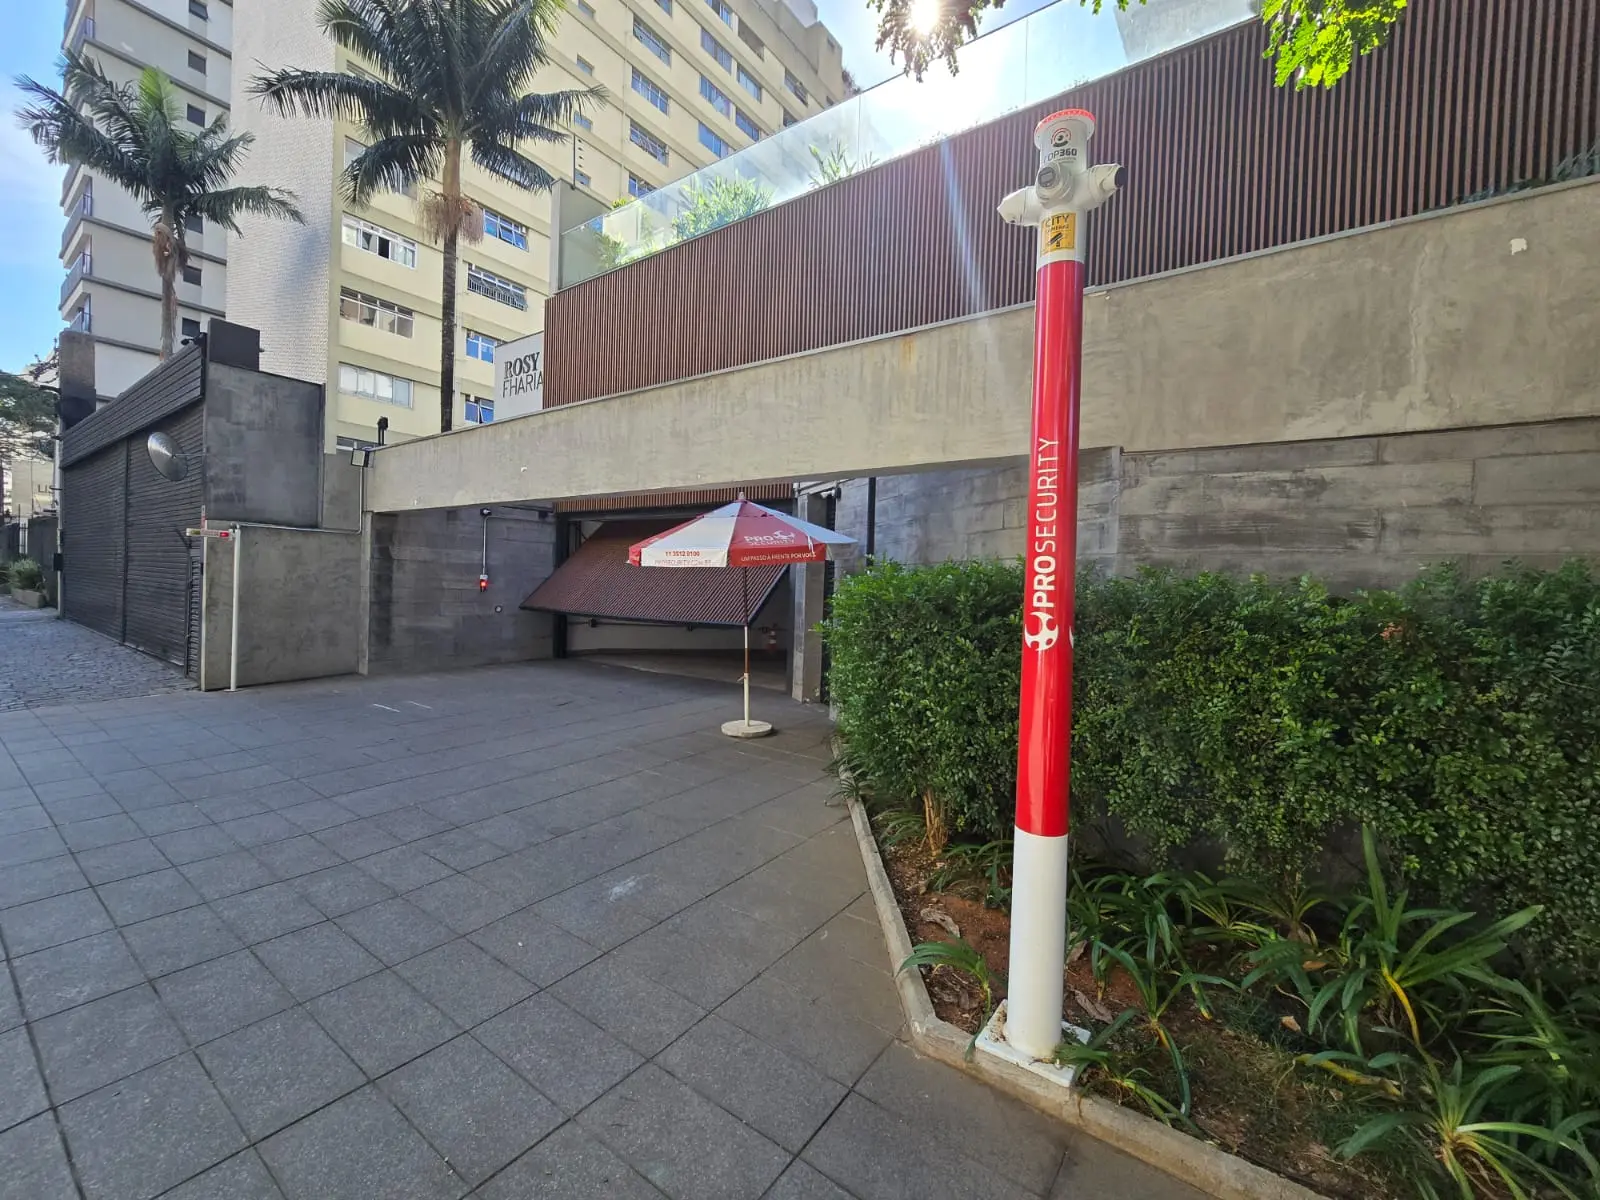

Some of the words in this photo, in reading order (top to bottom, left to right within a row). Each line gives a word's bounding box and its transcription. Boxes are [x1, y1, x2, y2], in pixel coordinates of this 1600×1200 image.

[1045, 214, 1069, 227] CITY
[504, 351, 540, 379] ROSY
[503, 370, 544, 397] FHARIA
